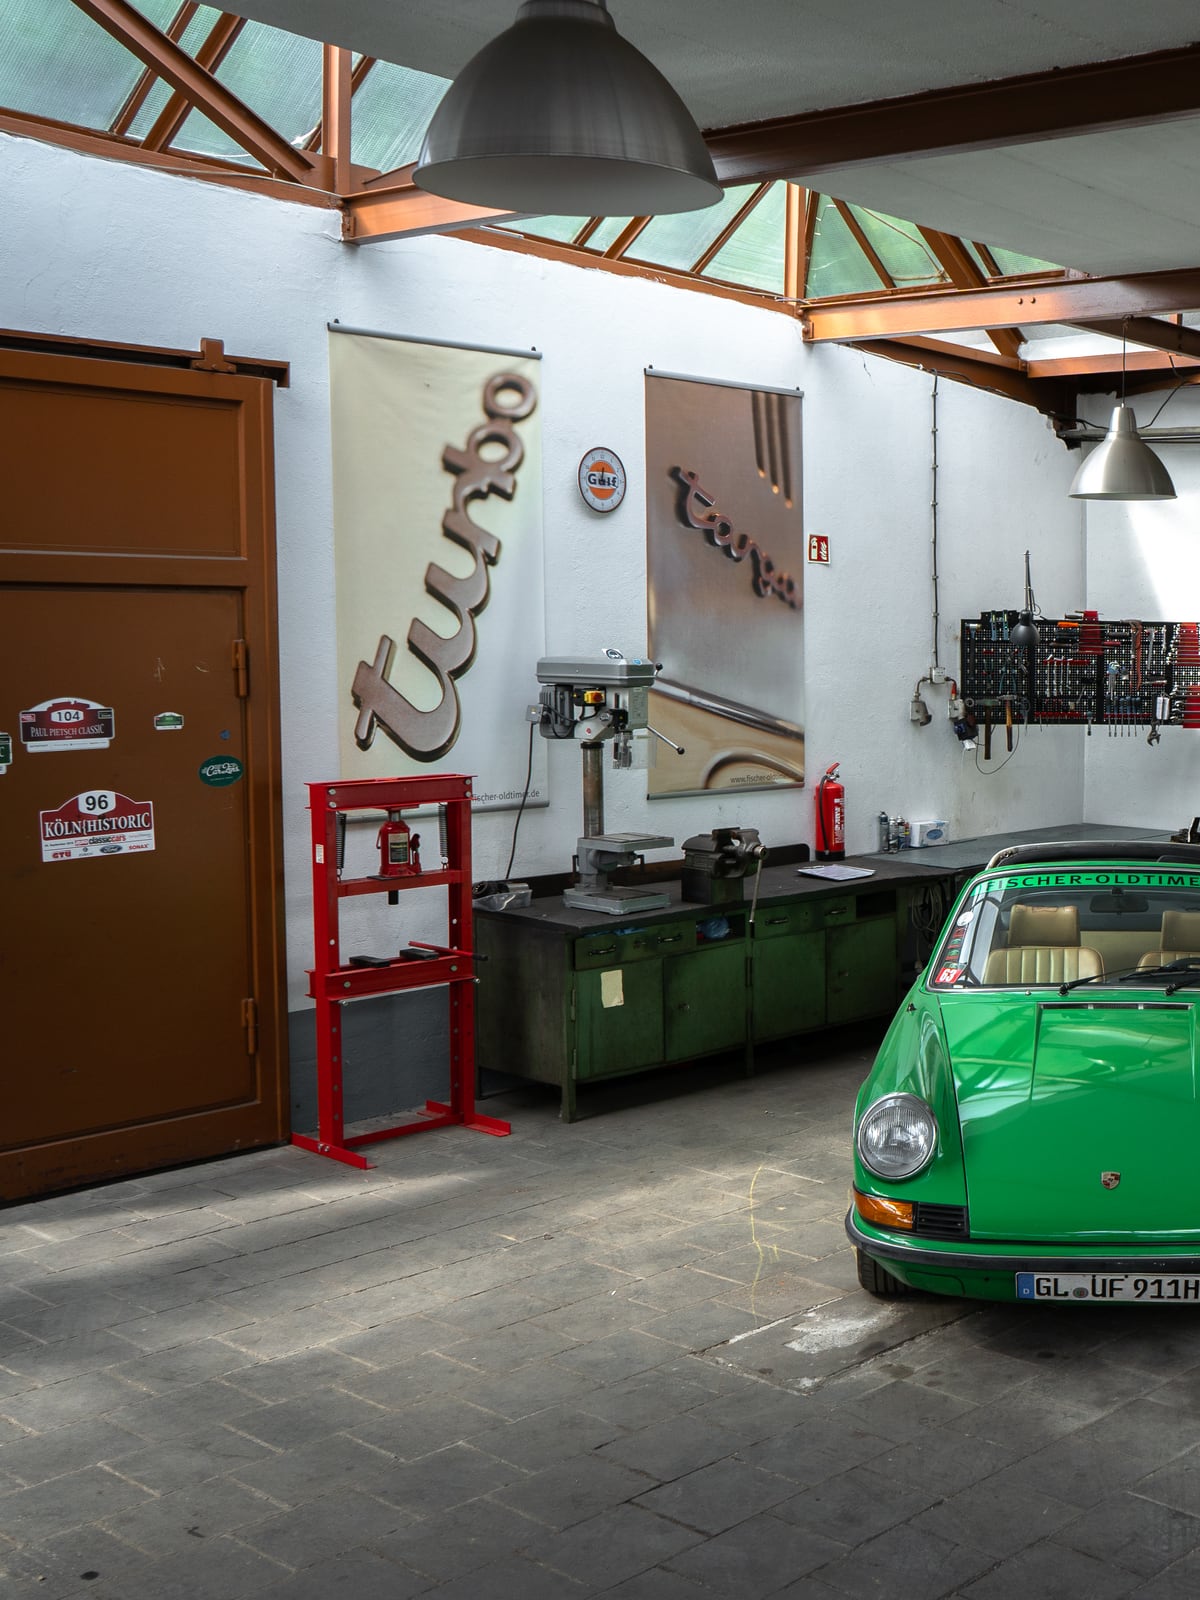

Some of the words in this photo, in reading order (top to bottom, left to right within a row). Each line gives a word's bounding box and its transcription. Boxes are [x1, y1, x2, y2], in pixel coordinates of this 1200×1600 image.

[588, 473, 618, 488] Gulf
[352, 374, 538, 763] turbo
[57, 711, 80, 721] 104
[30, 726, 49, 738] PAUL
[49, 727, 78, 737] PIETSCH
[77, 724, 104, 736] CLASSIC
[85, 795, 108, 810] 96
[938, 968, 957, 983] 63
[1035, 1277, 1069, 1297] GL
[1091, 1276, 1126, 1298] UF
[1133, 1278, 1200, 1300] 911H
